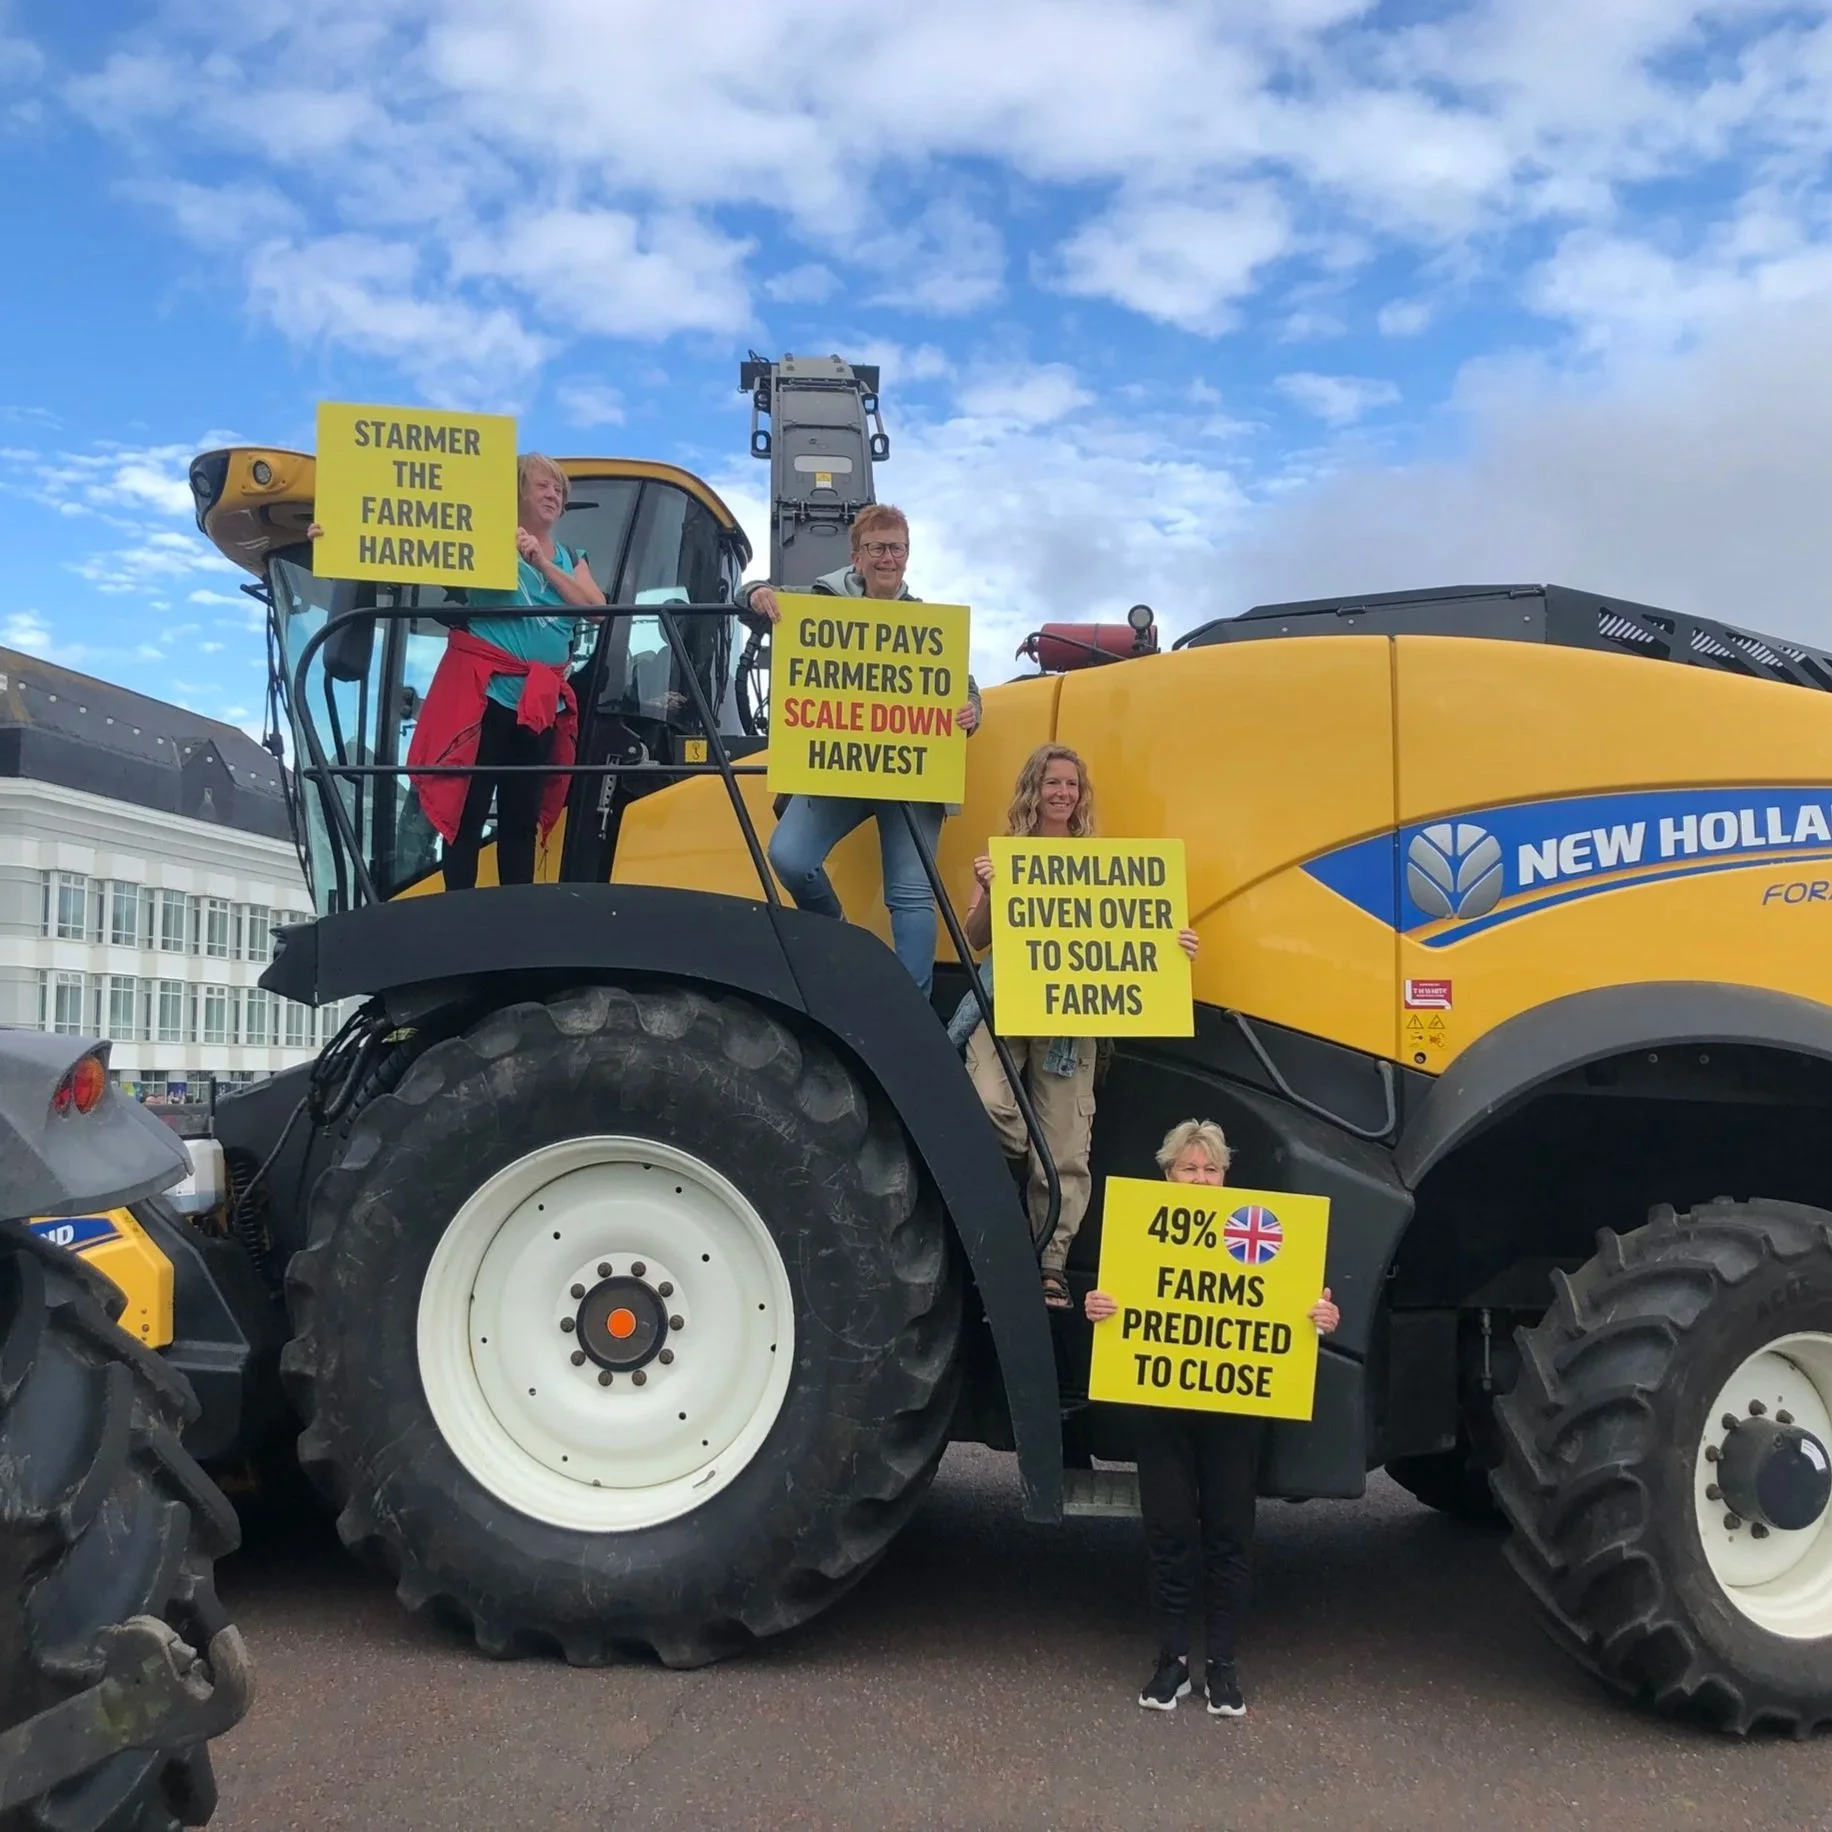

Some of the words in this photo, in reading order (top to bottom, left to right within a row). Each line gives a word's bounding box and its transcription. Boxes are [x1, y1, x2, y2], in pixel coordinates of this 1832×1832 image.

[355, 420, 480, 455] STARMER
[393, 461, 442, 490] THE
[363, 497, 472, 531] FARMER
[360, 536, 474, 570] HARMER
[800, 618, 869, 650] GOVT
[876, 624, 943, 656] PAYS
[790, 658, 913, 694] FARMERS
[919, 667, 950, 696] TO
[785, 698, 864, 731] SCALE
[871, 704, 952, 736] DOWN
[809, 740, 927, 775] HARVEST
[1518, 821, 1646, 886] NEW
[1659, 805, 1832, 857] HOLLA
[1012, 855, 1165, 886] FARMLAND
[1762, 881, 1832, 906] FOR
[1008, 897, 1092, 927] GIVEN
[1100, 898, 1173, 929] OVER
[1026, 940, 1061, 971] TO
[1068, 941, 1157, 971] SOLAR
[1046, 984, 1142, 1015] FARMS
[1148, 1206, 1216, 1248] 49%
[1158, 1267, 1264, 1307] FARMS
[1123, 1308, 1291, 1355] PREDICTED
[1134, 1354, 1171, 1387] TO
[1180, 1359, 1273, 1397] CLOSE
